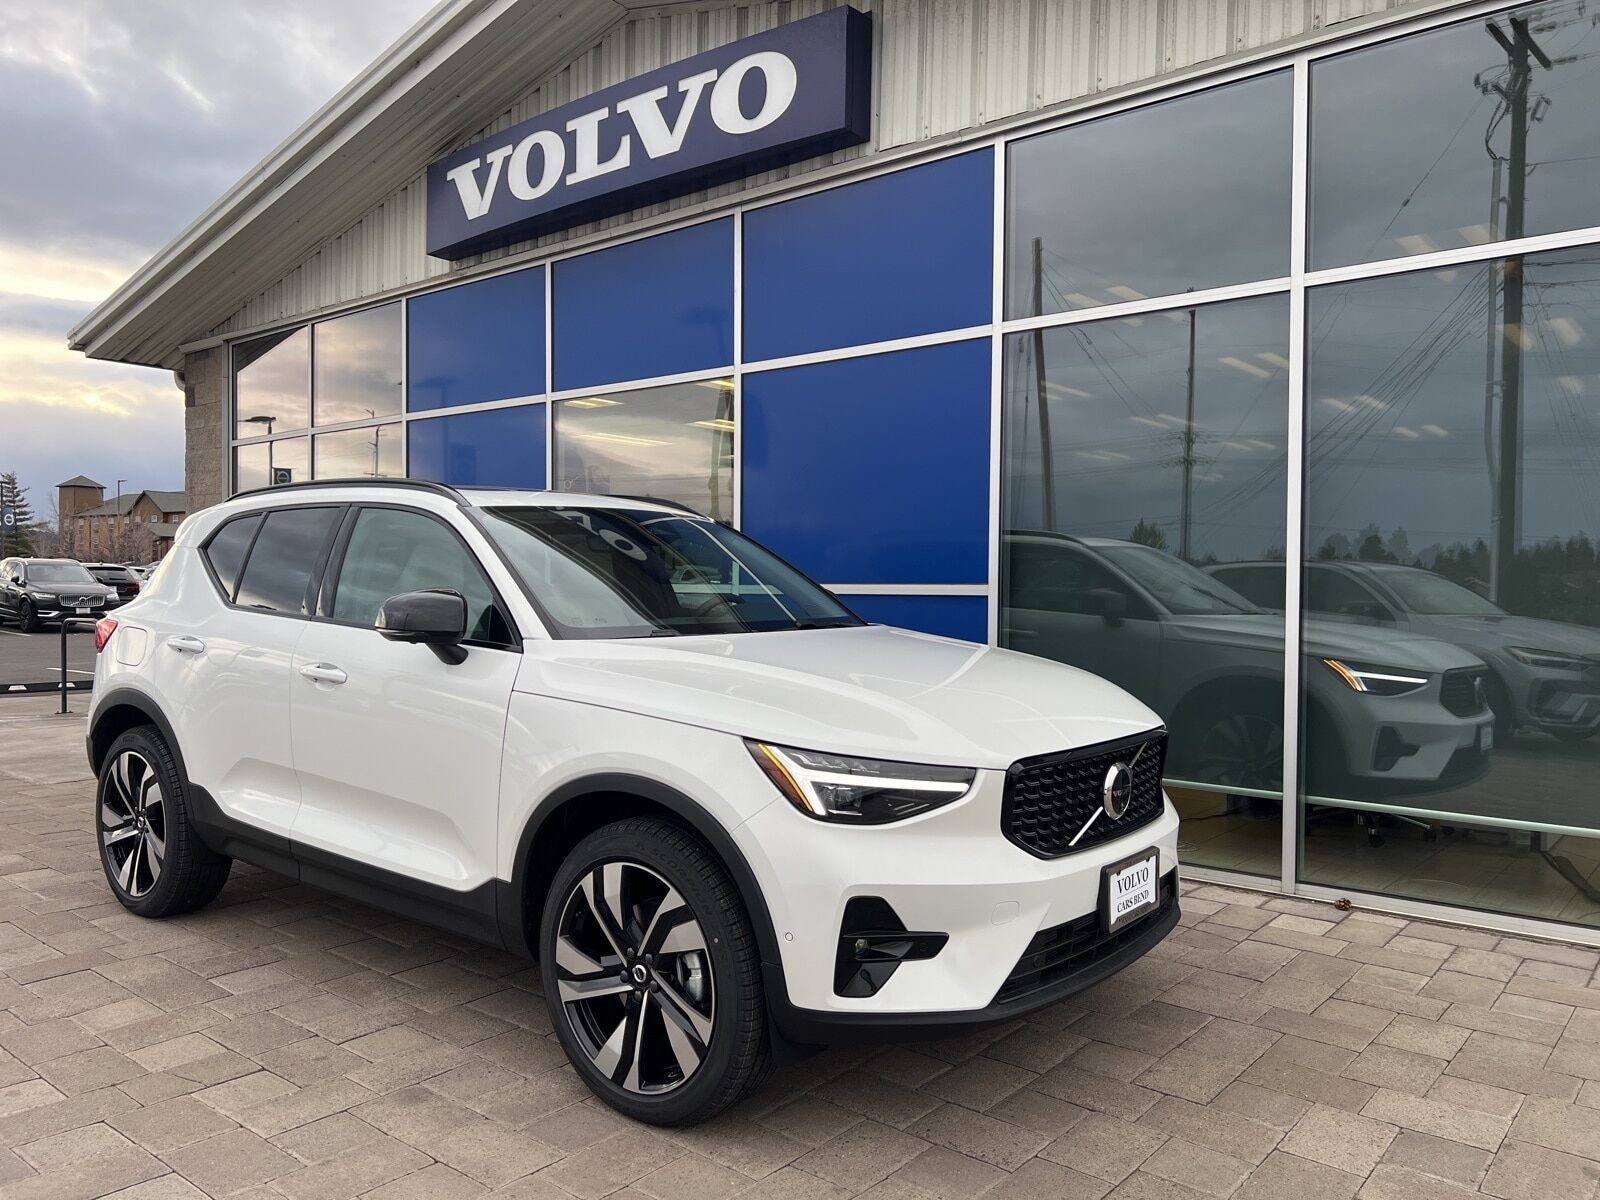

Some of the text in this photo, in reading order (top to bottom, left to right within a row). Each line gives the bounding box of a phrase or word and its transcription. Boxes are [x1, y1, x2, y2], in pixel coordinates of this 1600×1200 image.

[446, 51, 798, 221] VOLVO
[1117, 867, 1149, 893] VOLVO
[1117, 889, 1149, 913] CARS BEND
